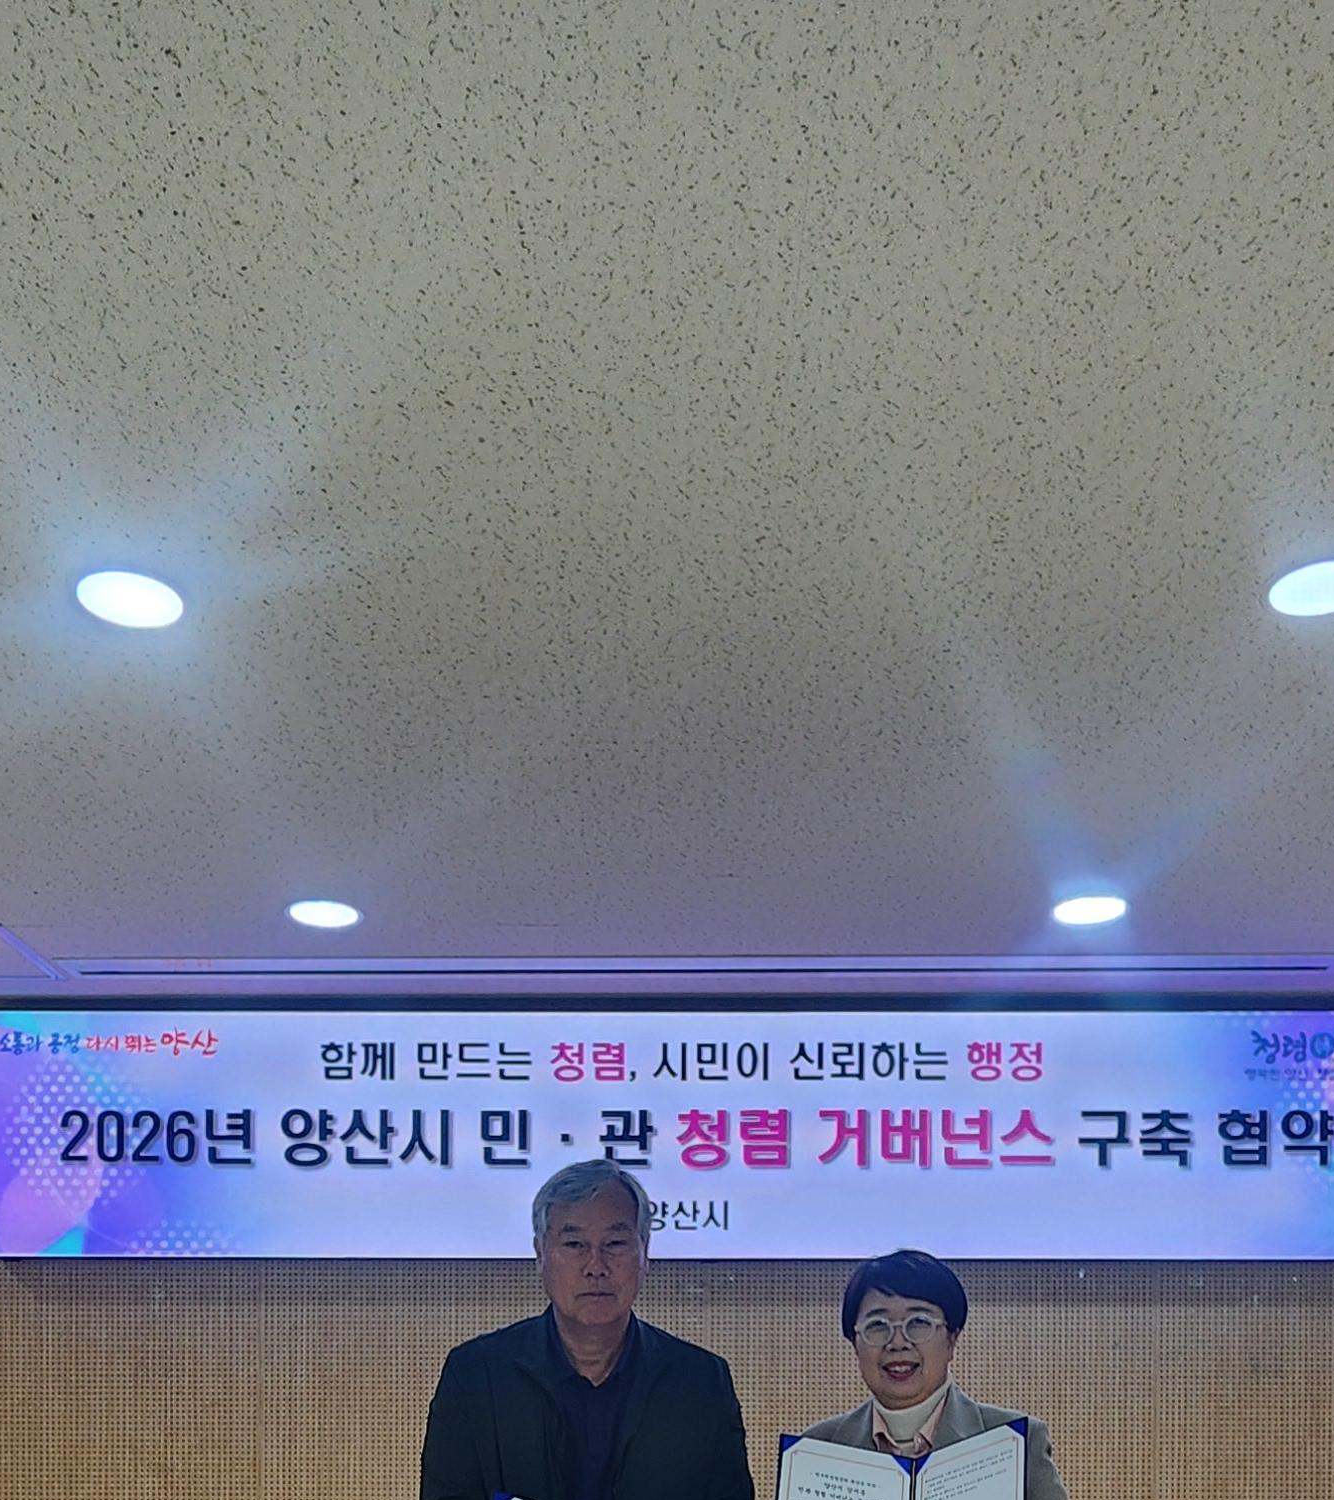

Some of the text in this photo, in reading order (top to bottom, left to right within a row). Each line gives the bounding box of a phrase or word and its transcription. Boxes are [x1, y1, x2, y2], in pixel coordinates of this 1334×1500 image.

[0, 1030, 42, 1055] 소통과
[86, 1034, 118, 1052] 다시
[124, 1033, 157, 1053] 뛰는
[160, 1027, 219, 1056] 양산
[320, 1041, 1044, 1083] 함께 만드는 청렴, 시민이 신뢰하는 행정
[59, 1107, 254, 1167] 2026년
[279, 1107, 452, 1168] 양산시
[480, 1108, 530, 1167] 민
[599, 1108, 655, 1167] 관
[675, 1107, 791, 1169] 청렴
[817, 1107, 1056, 1169] 거버넌스
[1078, 1108, 1192, 1168] 구축
[649, 1200, 729, 1232] 양산시
